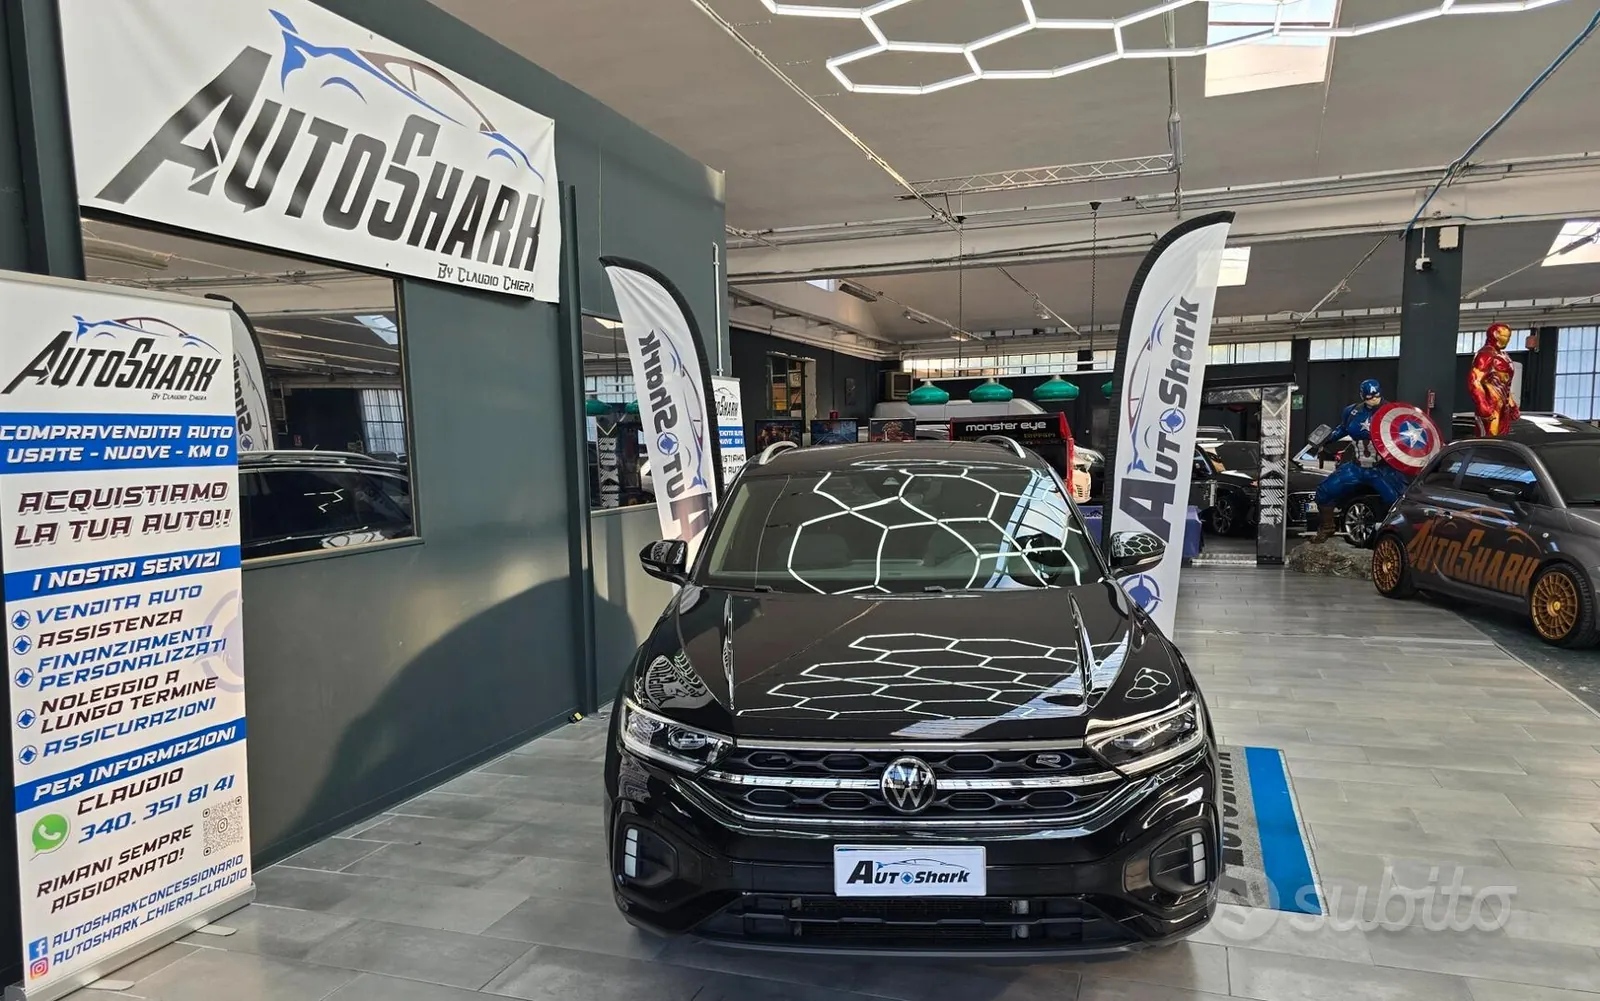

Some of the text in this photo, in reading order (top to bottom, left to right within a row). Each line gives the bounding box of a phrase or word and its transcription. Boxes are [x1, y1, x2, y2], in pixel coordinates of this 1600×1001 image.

[1, 331, 222, 394] AUTOSHARK
[0, 425, 233, 441] COMPRAVENDITA AUTO
[965, 421, 1047, 431] monster eye
[6, 447, 84, 463] USATE
[104, 445, 171, 460] NUOVE
[188, 445, 211, 458] KM
[18, 482, 229, 514] ACQUISTIAMO
[14, 509, 231, 547] LA TUA AUTO!!
[32, 551, 221, 591] I NOSTRI SERVIZI
[36, 585, 203, 624] VENDITA AUTO
[38, 609, 183, 649] ASSISTENZA
[38, 625, 213, 673] FINANZIAMENTI
[38, 638, 226, 692] PERSONALIZZATI
[40, 669, 180, 716] NOLEGGIO A
[41, 676, 219, 734] LUNGO TERMINE
[42, 697, 216, 758] ASSICURAZIONI
[33, 726, 237, 801] PER INFORMAZIONI
[77, 767, 184, 816] CLAUDIO
[143, 794, 182, 820] 351
[187, 784, 210, 804] 81
[213, 774, 235, 792] 41
[36, 825, 194, 897] RIMANI SEMPRE
[51, 847, 185, 914] AGGIORNATO!
[52, 854, 244, 948] AUTOSHARKCONCESSIONARIO
